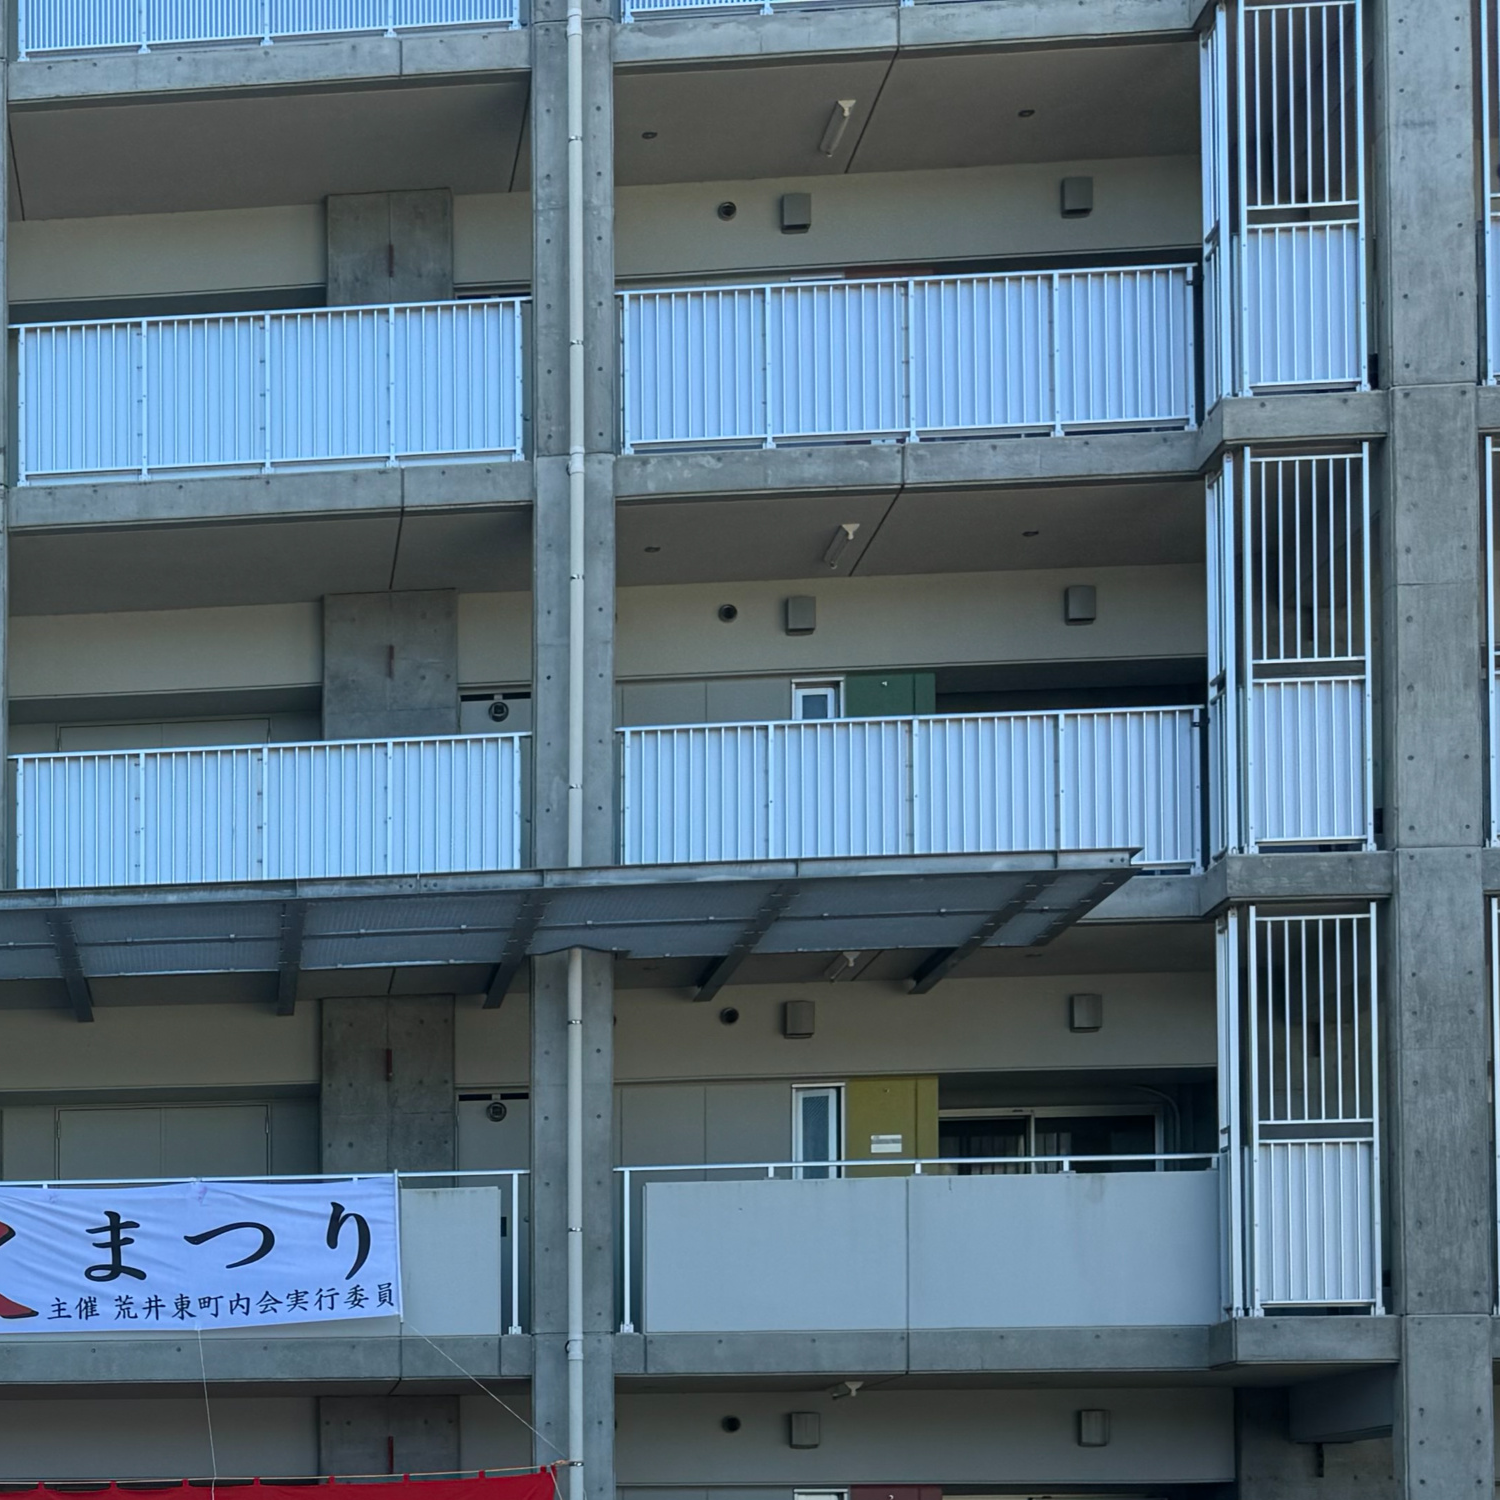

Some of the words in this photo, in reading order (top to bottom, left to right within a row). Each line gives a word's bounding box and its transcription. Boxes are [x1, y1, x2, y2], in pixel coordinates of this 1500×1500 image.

[47, 1296, 100, 1321] 主催
[113, 1282, 395, 1321] 荒井東町内会実行委員
